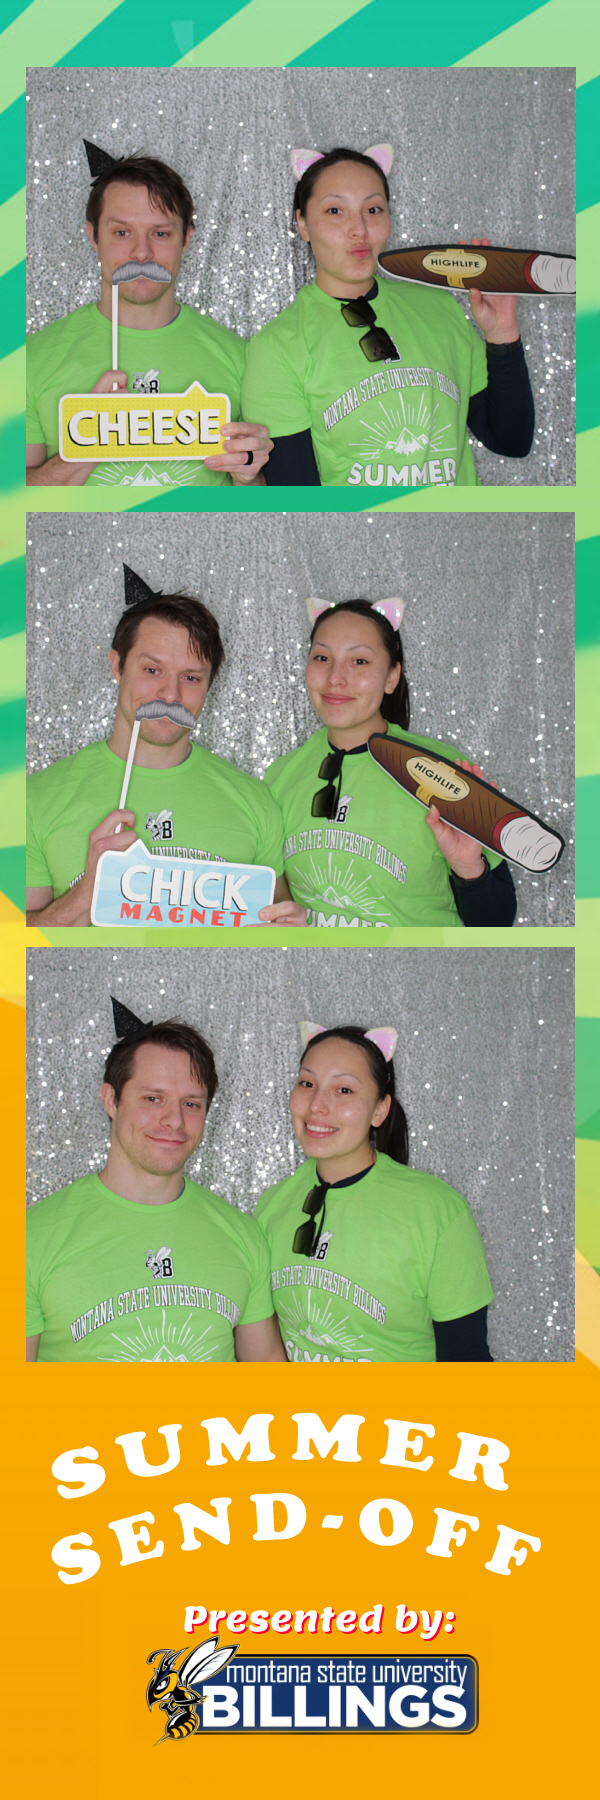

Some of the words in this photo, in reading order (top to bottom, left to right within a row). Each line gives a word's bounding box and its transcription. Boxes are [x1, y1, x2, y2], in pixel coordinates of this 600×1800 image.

[430, 258, 480, 269] HIGHLIFE
[323, 386, 361, 432] MONTANA
[359, 372, 388, 402] STATE
[386, 367, 436, 390] UNIVERSITY
[67, 408, 221, 446] CHEESE
[346, 457, 457, 486] SUMMER
[414, 761, 462, 796] HIGHLIFE
[298, 828, 323, 852] STATE
[324, 828, 374, 861] UNIVERSITY
[374, 850, 408, 885] BILLINGS
[120, 864, 251, 911] CHICK
[120, 903, 247, 927] MAGNET
[70, 1297, 115, 1343] MONTANA
[118, 1286, 150, 1316] STATE
[152, 1284, 213, 1311] UNIVERSITY
[281, 1264, 304, 1288] STATE
[304, 1264, 353, 1301] UNIVERSITY
[352, 1283, 387, 1325] BILLINGS
